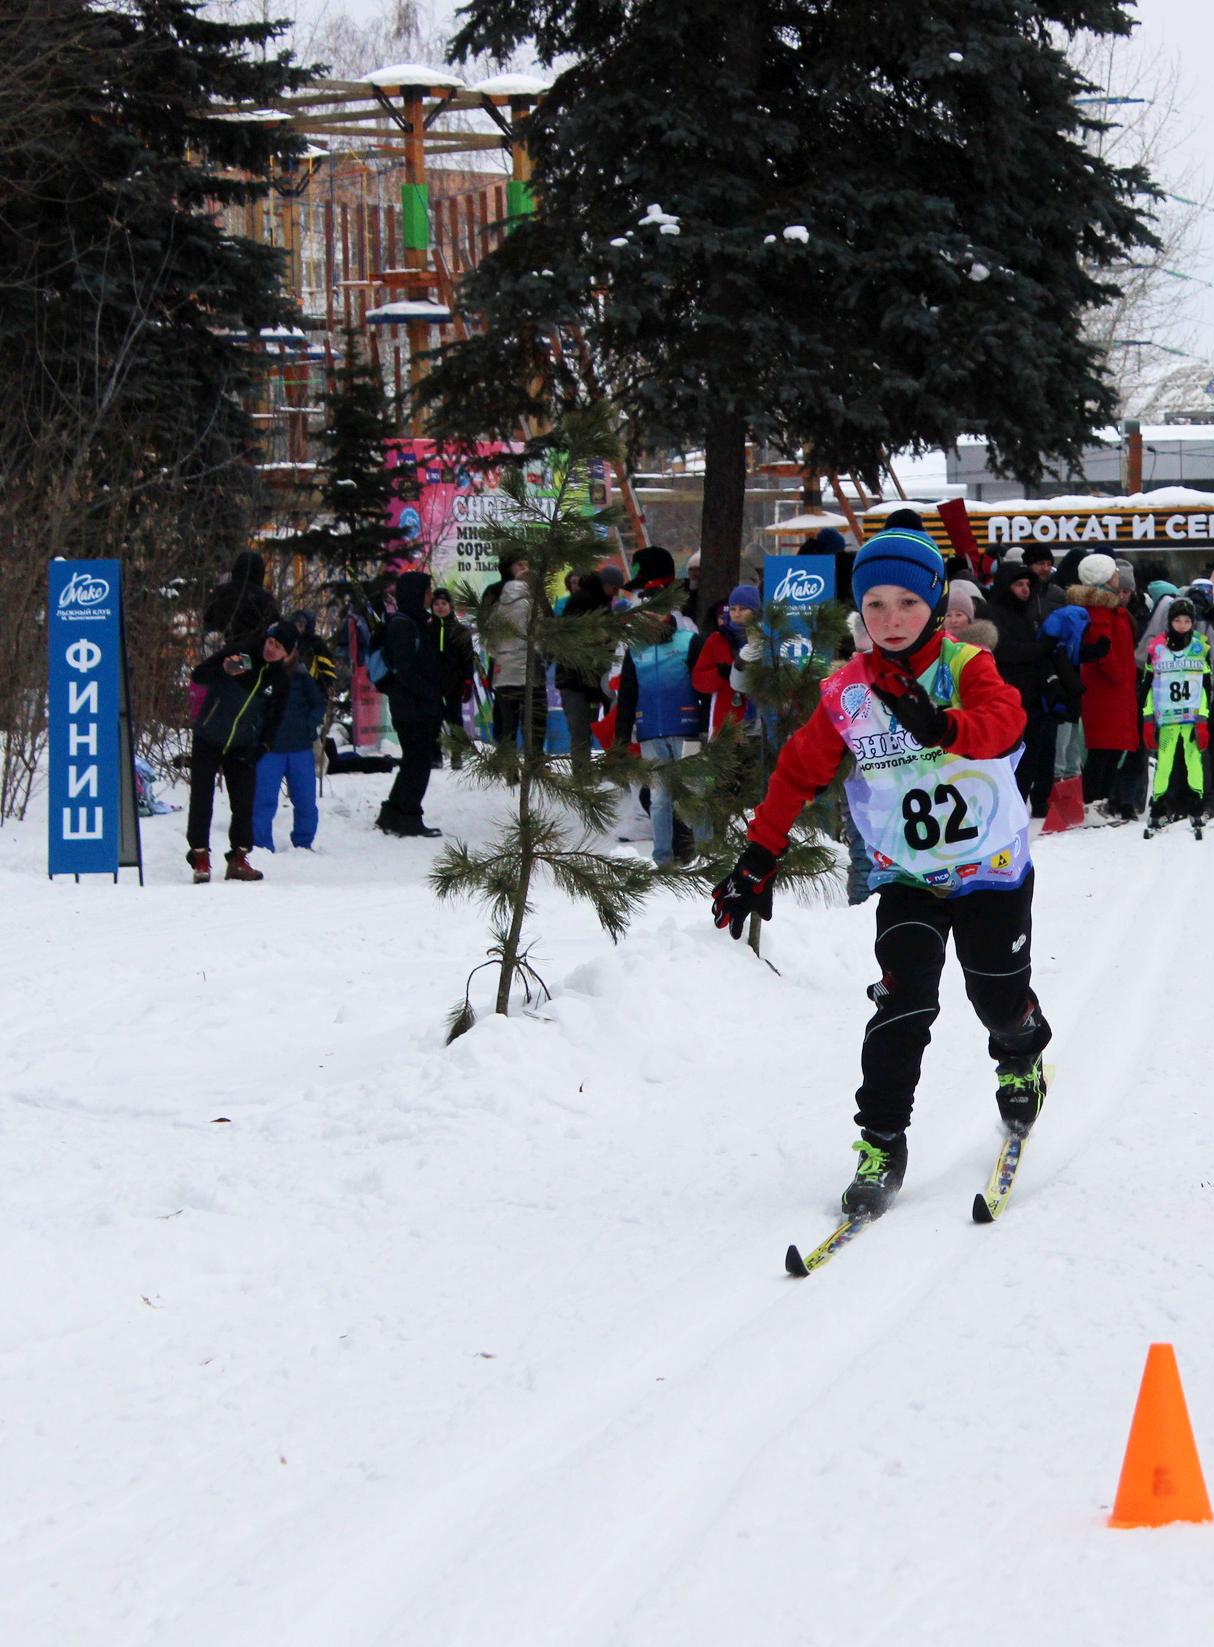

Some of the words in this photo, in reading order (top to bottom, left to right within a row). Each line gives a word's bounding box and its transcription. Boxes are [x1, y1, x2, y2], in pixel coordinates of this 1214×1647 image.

[988, 515, 1122, 543] ПРОКАТ
[1132, 513, 1155, 541] И
[1170, 680, 1191, 702] 84
[63, 638, 103, 840] ФИНИШ
[902, 783, 979, 851] 82
